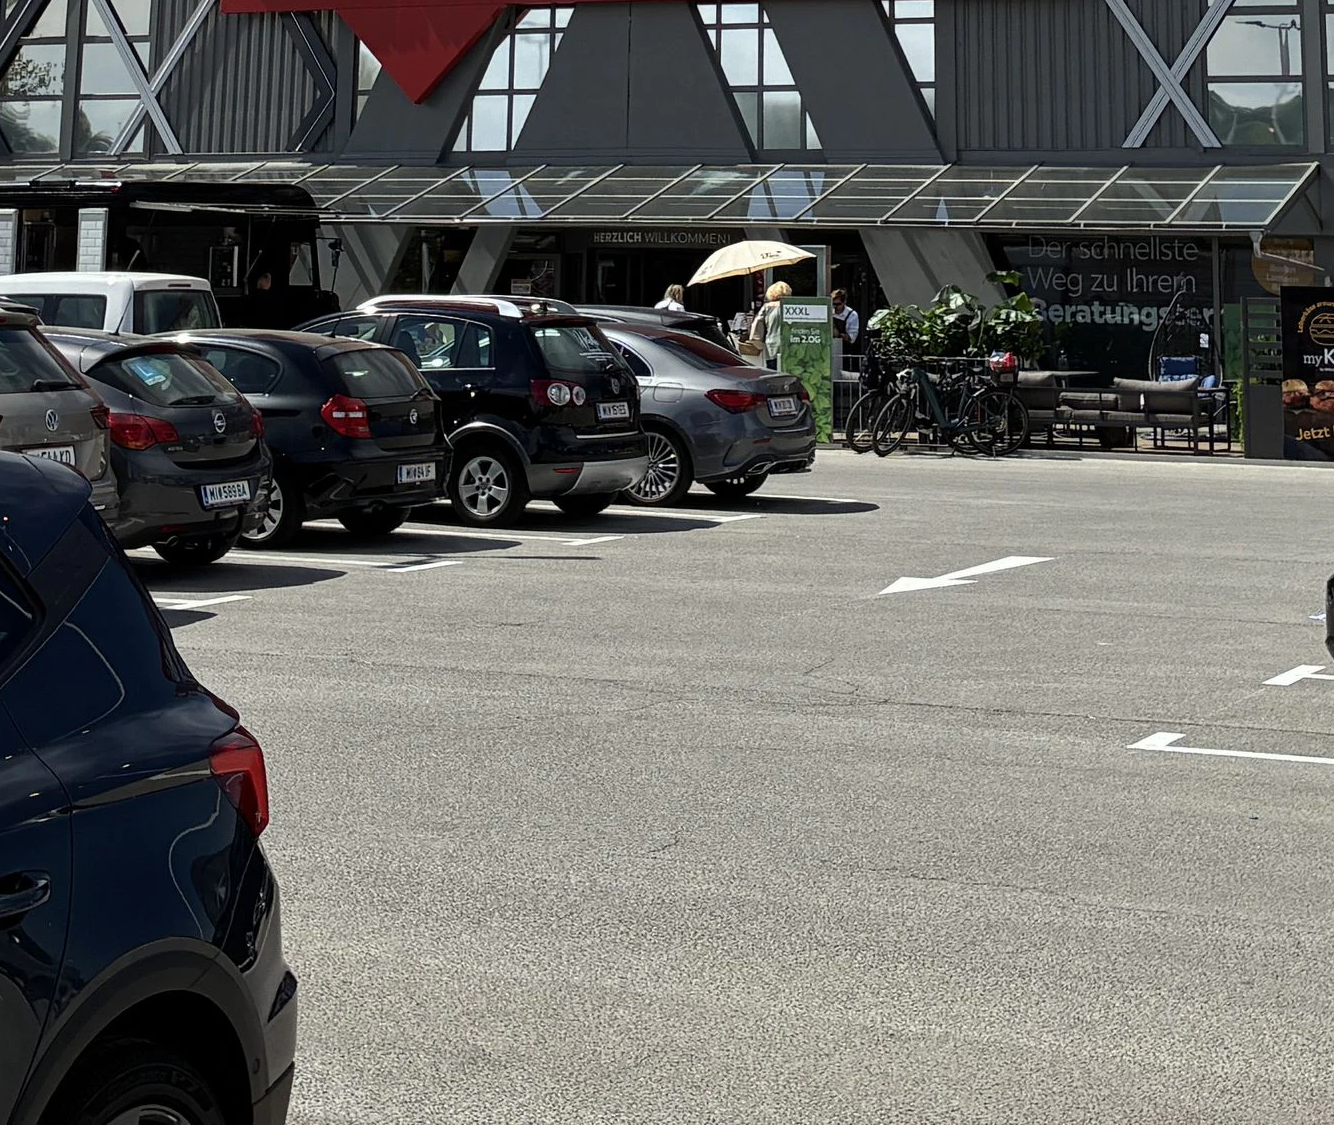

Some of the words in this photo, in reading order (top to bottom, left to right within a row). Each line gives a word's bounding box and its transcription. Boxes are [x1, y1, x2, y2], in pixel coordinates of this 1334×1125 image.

[593, 232, 642, 243] HERZLICH
[1028, 235, 1071, 259] Der
[1079, 236, 1199, 261] schnellste
[1026, 266, 1083, 297] Weg
[1091, 274, 1117, 292] zu
[1126, 267, 1196, 293] Ihrem
[785, 306, 810, 316] XXXL
[790, 335, 801, 343] im
[801, 335, 821, 344] 2.OG
[1295, 427, 1331, 441] Jetzt
